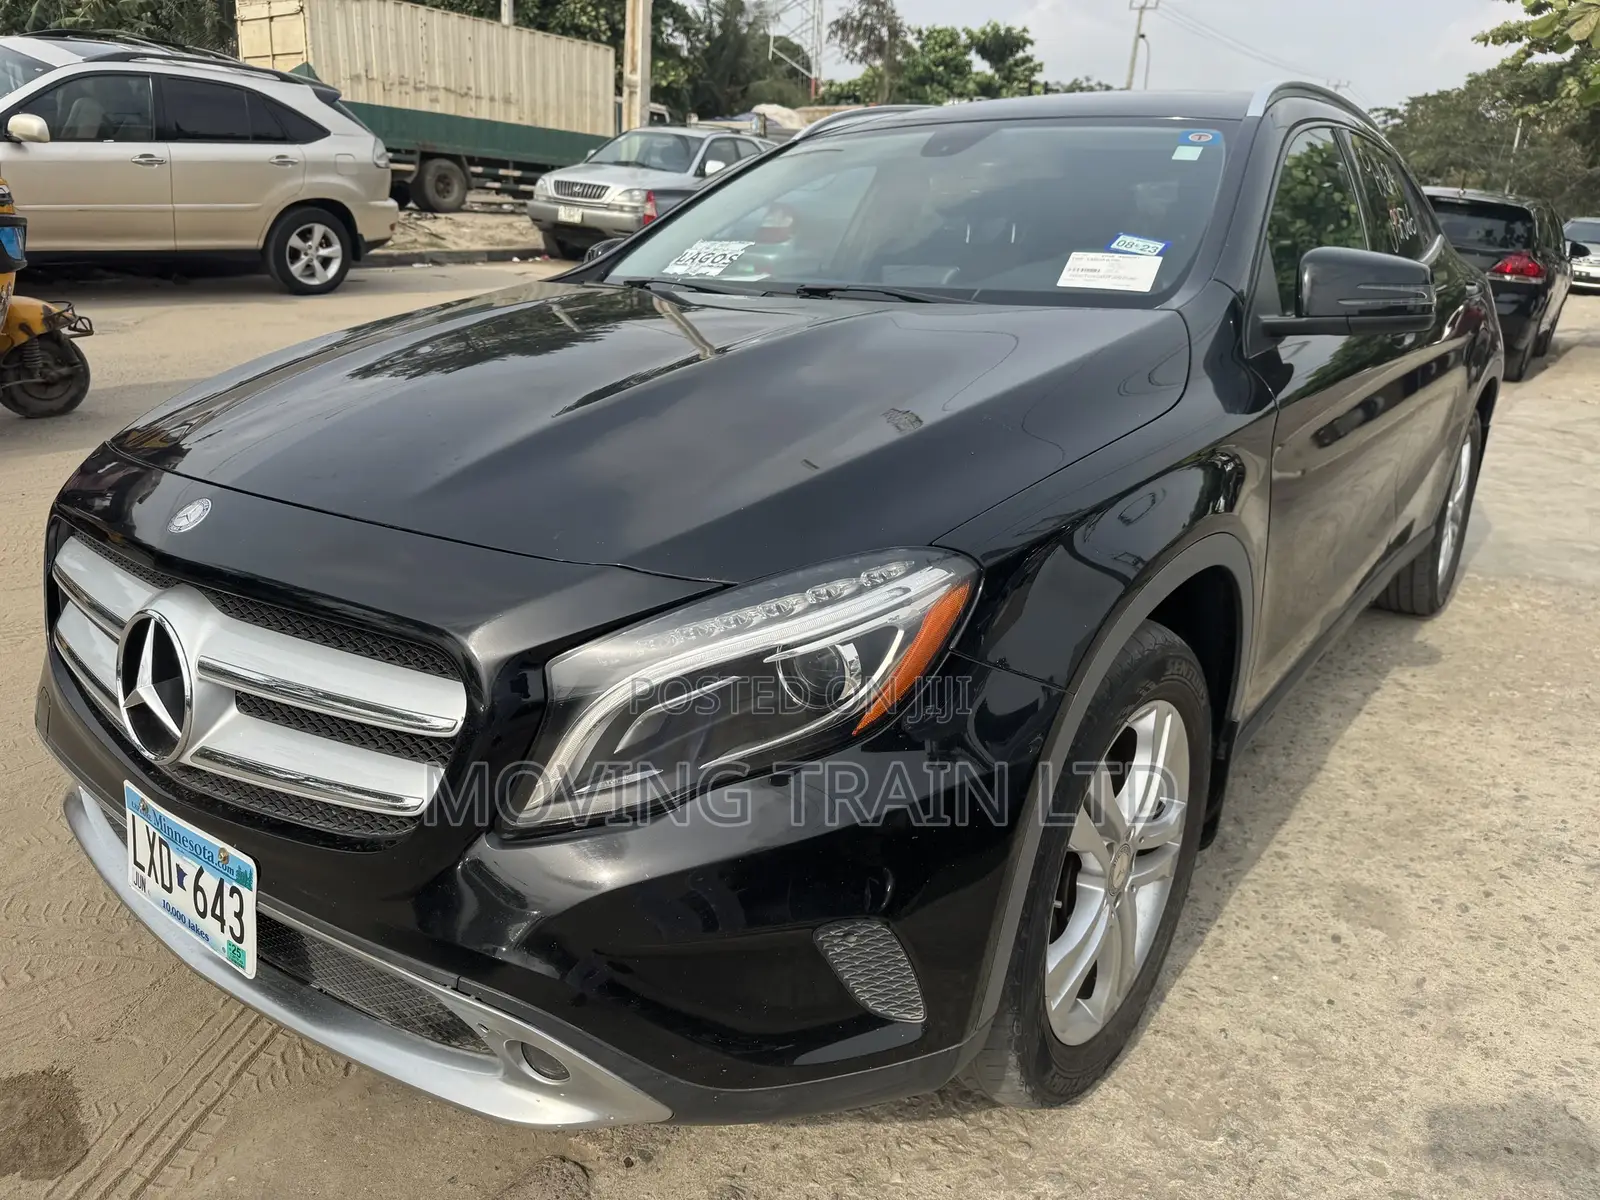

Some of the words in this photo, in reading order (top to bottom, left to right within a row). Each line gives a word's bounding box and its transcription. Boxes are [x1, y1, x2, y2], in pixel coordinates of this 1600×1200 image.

[1116, 239, 1135, 249] 08
[1139, 244, 1160, 254] 23
[675, 251, 740, 265] LAGOS
[131, 813, 174, 895] LXD
[193, 865, 245, 945] 643
[133, 870, 147, 894] JUN
[162, 899, 187, 925] 10,000
[188, 918, 210, 943] lakes
[231, 943, 242, 959] 25
